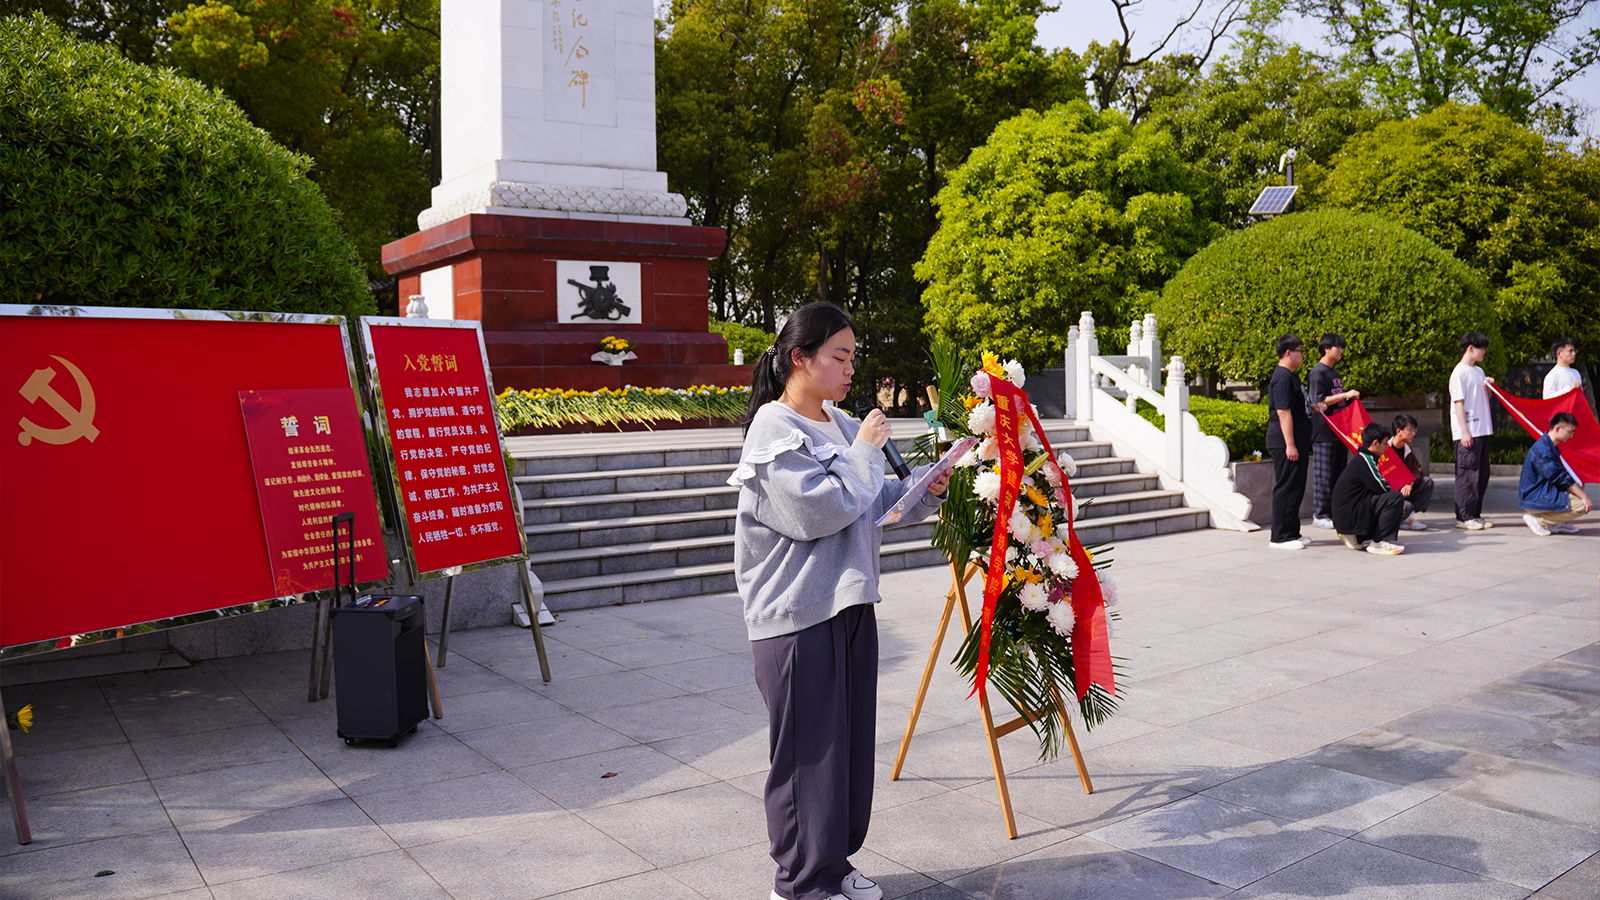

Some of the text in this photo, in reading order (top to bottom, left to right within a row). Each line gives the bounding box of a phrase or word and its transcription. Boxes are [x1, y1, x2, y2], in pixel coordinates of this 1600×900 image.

[564, 0, 589, 107] 纪念碑
[403, 353, 459, 372] 入党誓词
[404, 386, 480, 398] 我志愿加入中国共产
